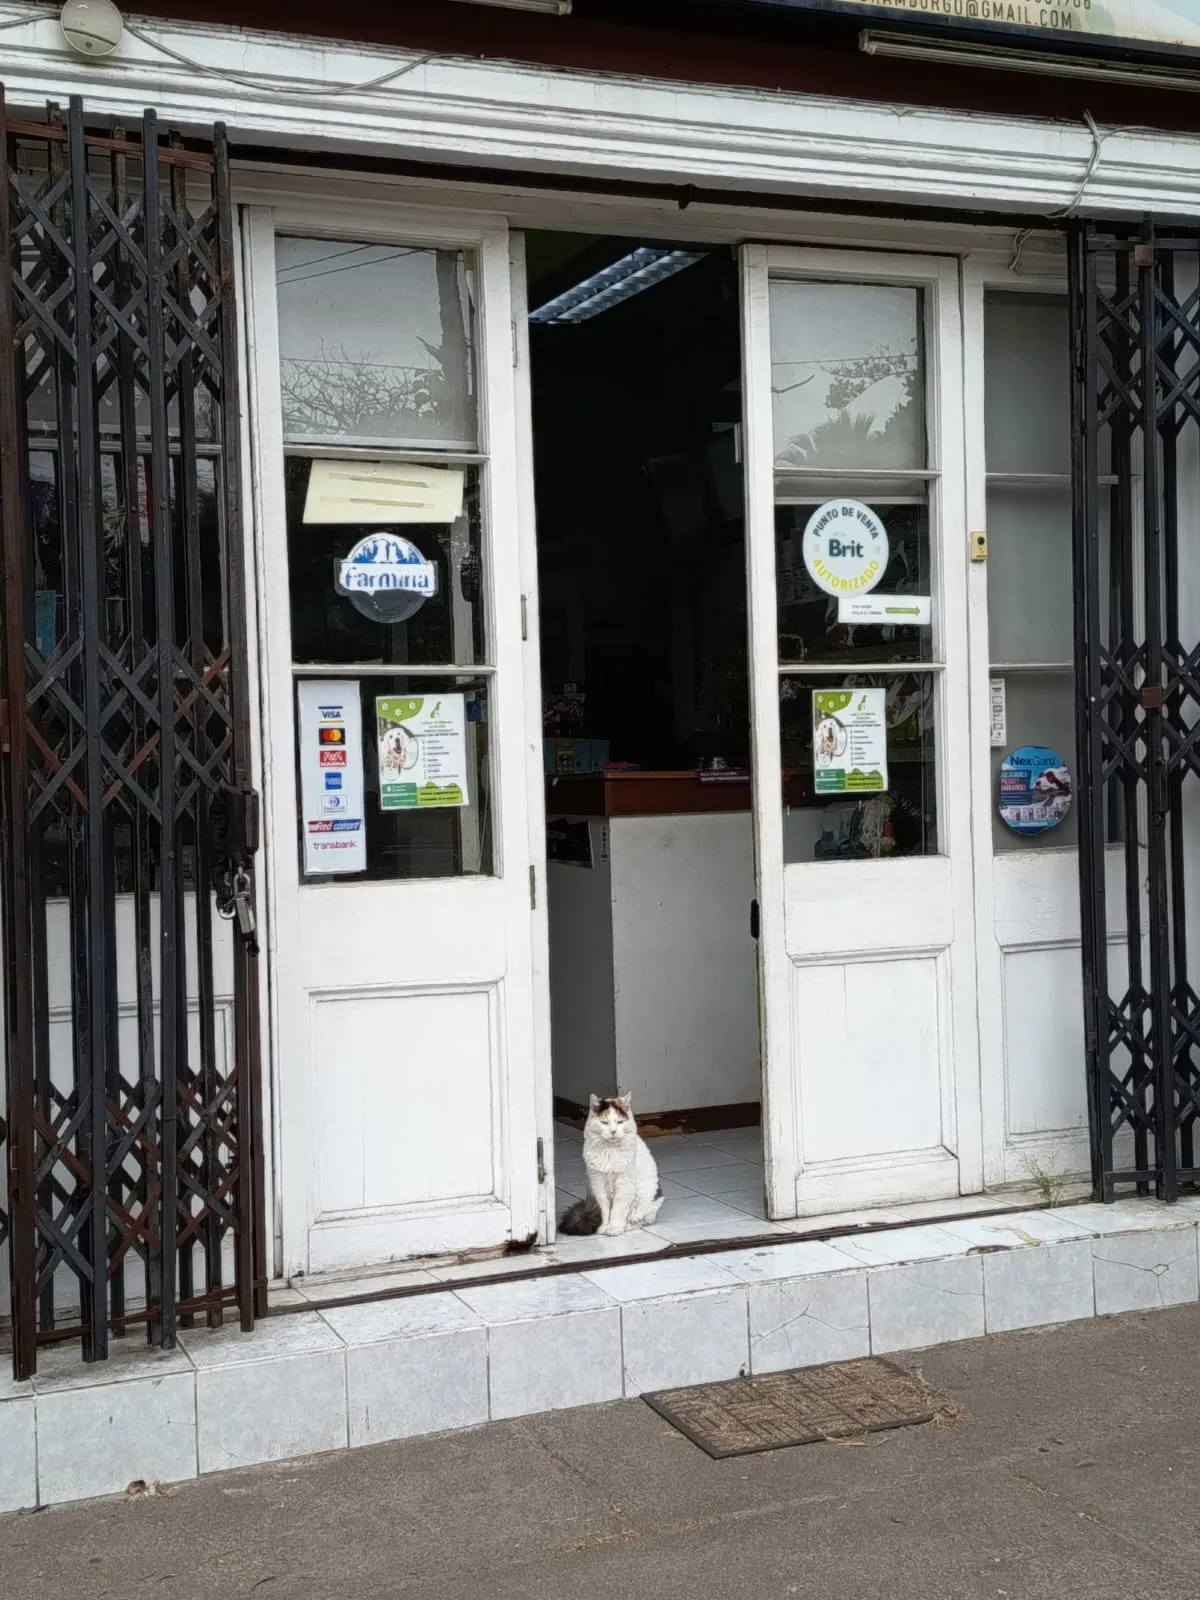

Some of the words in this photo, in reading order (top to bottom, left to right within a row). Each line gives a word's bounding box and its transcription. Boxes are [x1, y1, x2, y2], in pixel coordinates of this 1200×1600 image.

[813, 508, 839, 536] PUNTO
[842, 507, 854, 517] DE
[857, 510, 879, 539] VENTA
[828, 538, 864, 558] Brit
[813, 559, 879, 590] AUTORIZADO
[321, 710, 341, 719] VISA
[1010, 755, 1056, 766] NexGard
